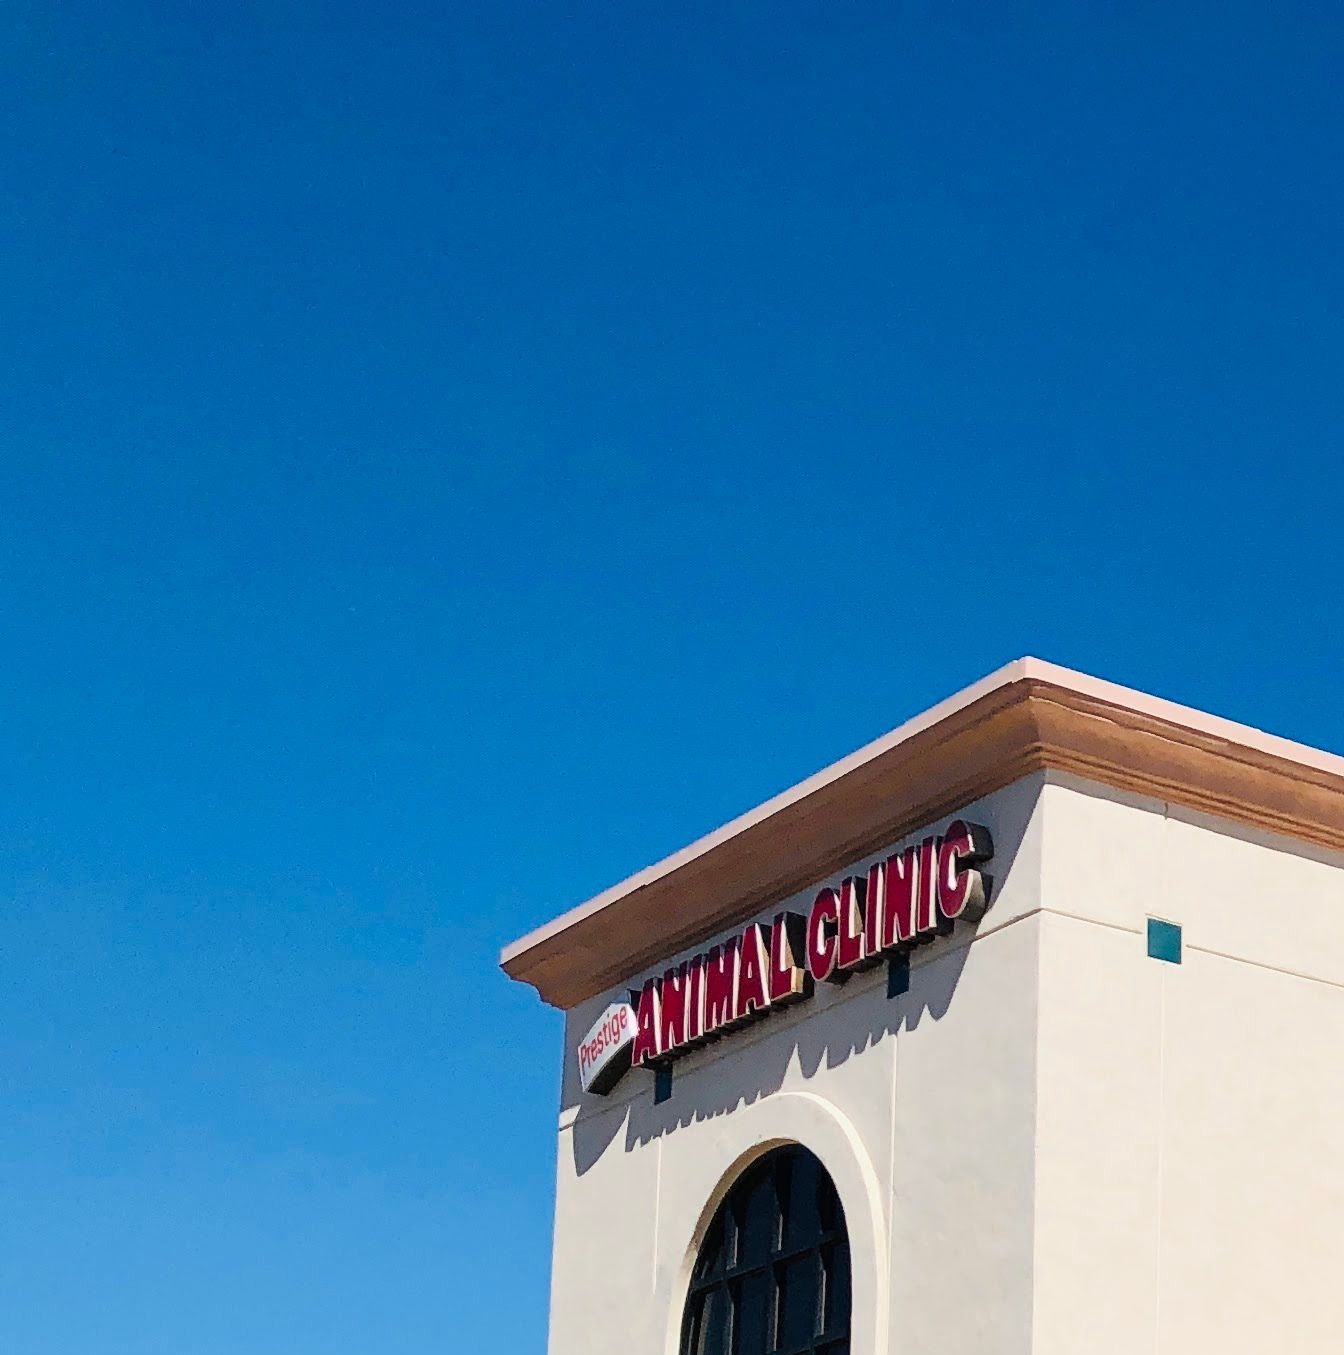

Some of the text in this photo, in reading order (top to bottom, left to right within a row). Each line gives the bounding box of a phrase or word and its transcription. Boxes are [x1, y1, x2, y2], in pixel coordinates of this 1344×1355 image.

[632, 819, 980, 1066] ANIMAL CLINIC
[580, 1006, 628, 1077] Prestige
